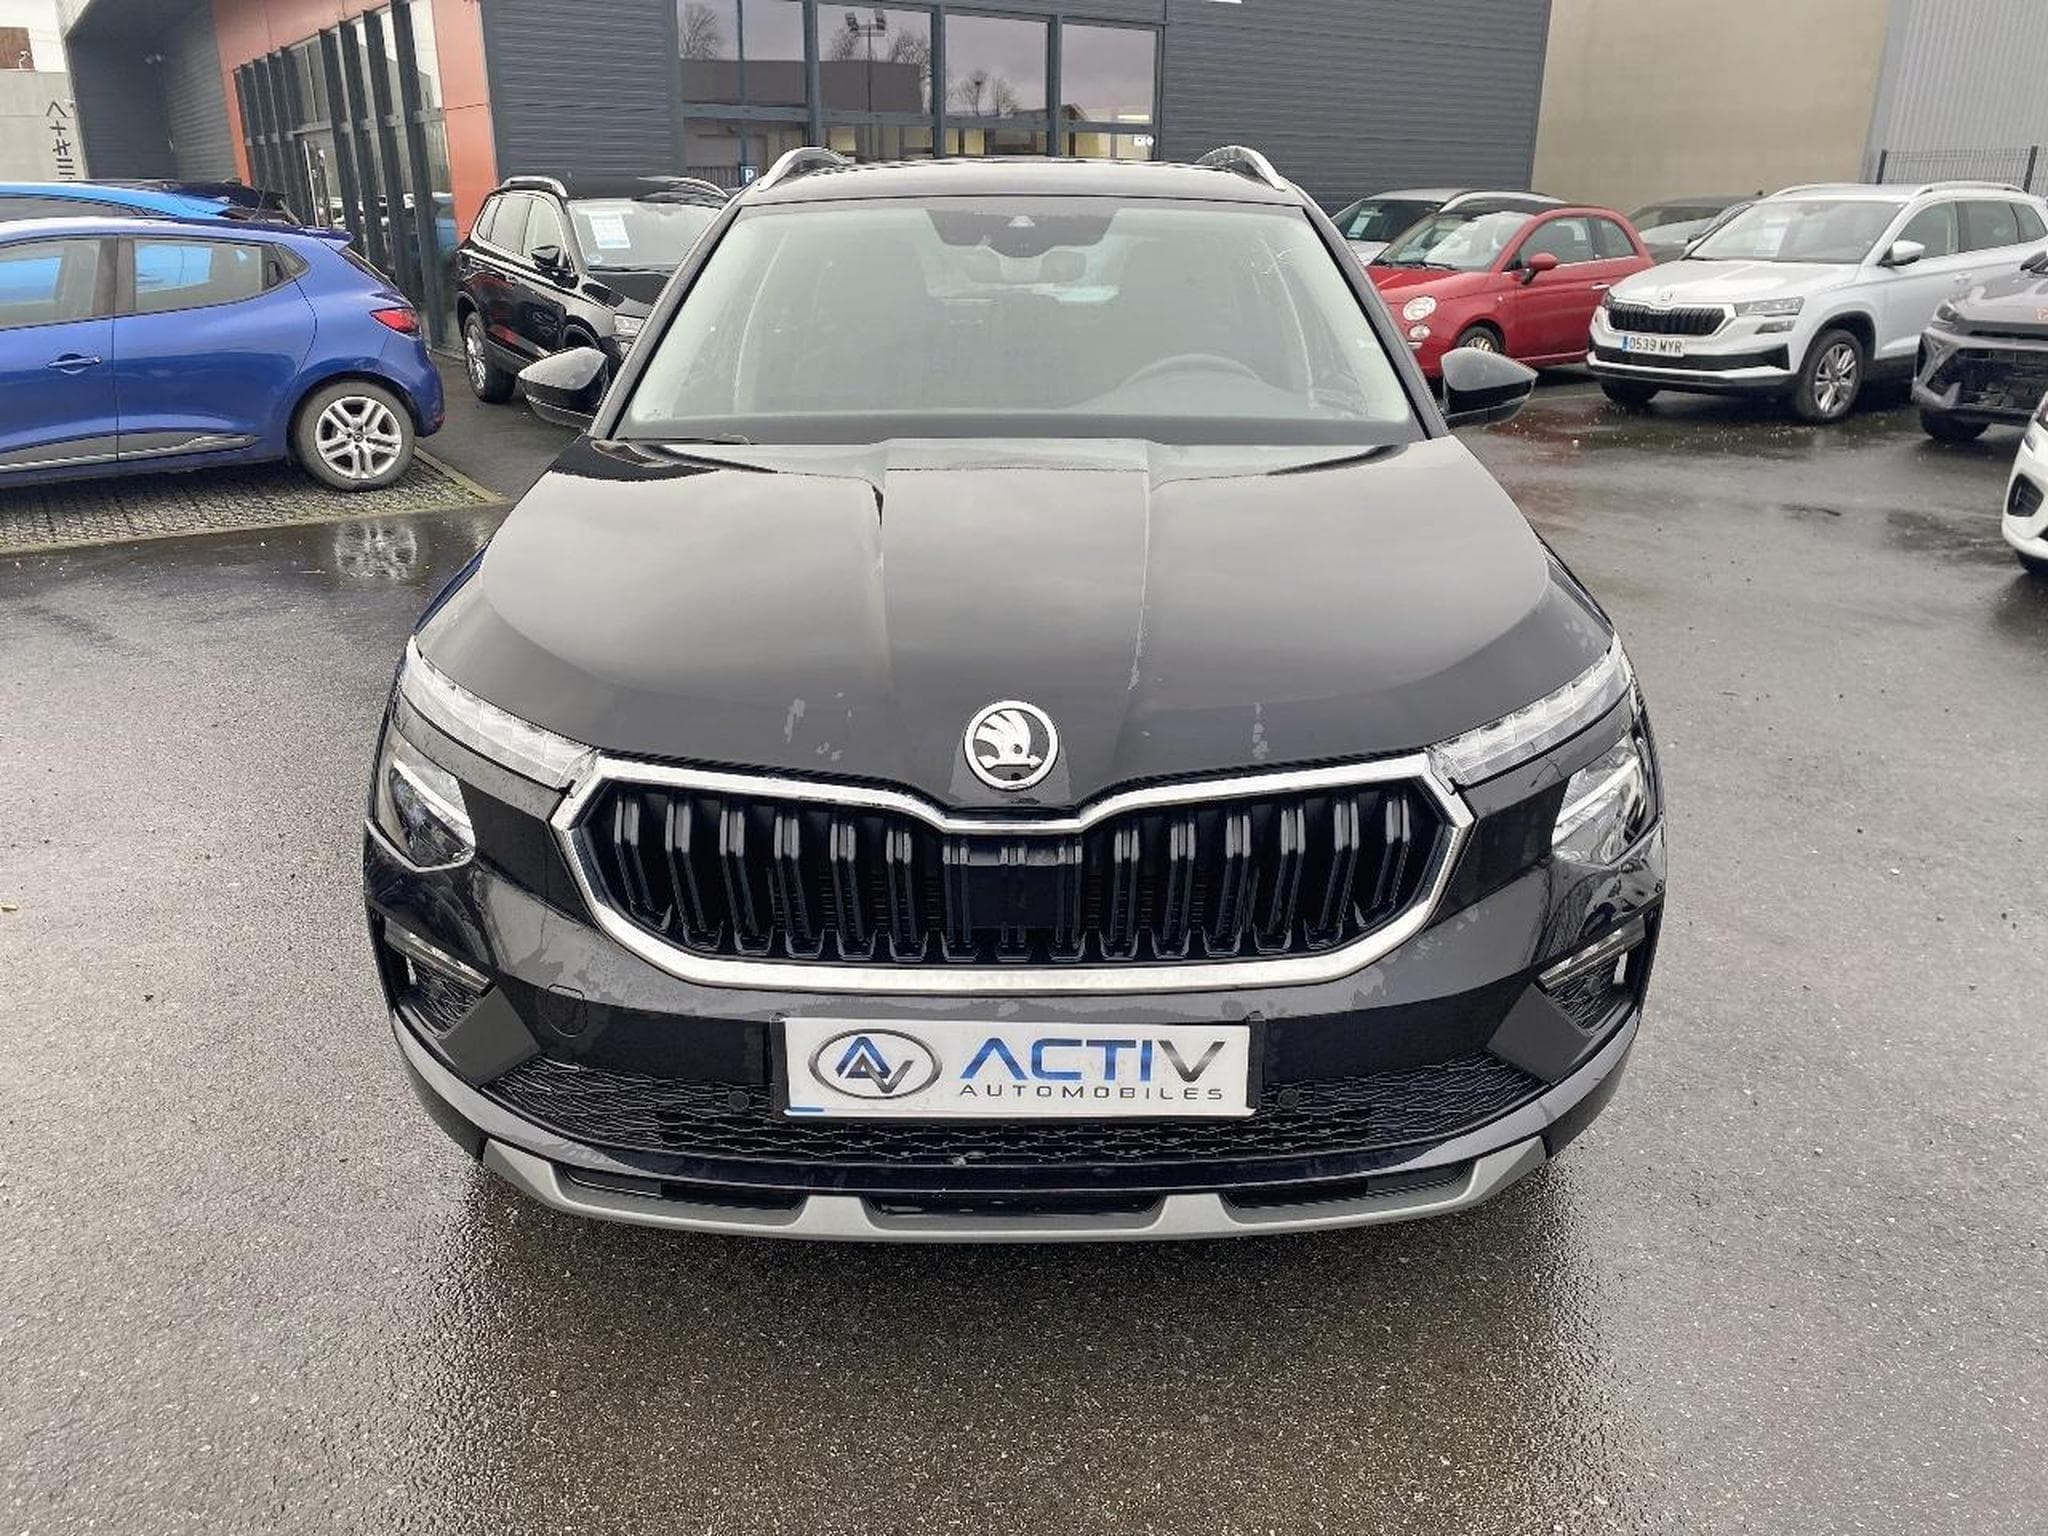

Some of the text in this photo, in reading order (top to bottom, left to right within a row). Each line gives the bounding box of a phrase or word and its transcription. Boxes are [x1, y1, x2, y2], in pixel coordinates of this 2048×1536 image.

[745, 169, 754, 183] P
[1630, 336, 1657, 351] 0539
[960, 1037, 1226, 1083] ACTIV
[960, 1083, 1223, 1100] AUTOMOBILES
